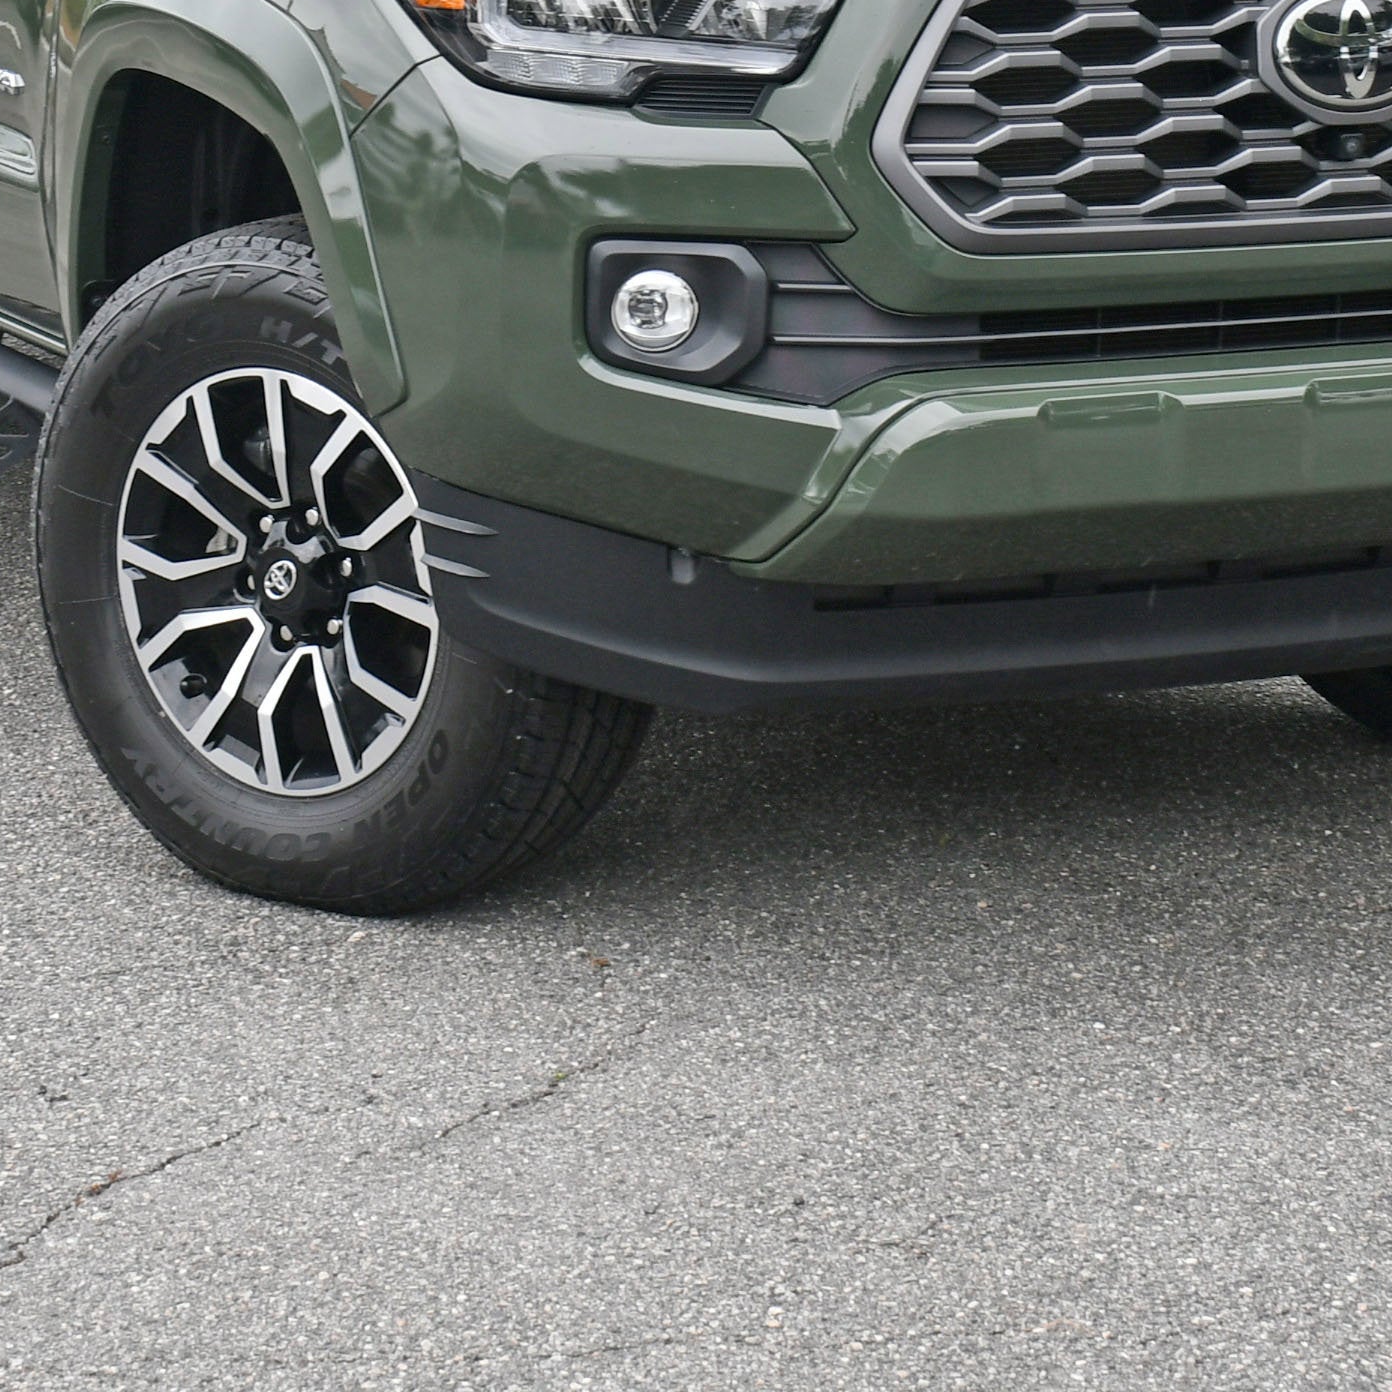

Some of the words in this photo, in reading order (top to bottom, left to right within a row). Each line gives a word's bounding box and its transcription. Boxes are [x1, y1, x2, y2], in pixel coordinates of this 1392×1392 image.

[258, 316, 345, 365] H/T
[121, 748, 331, 862] COUNTRY
[353, 729, 449, 837] OPEN
